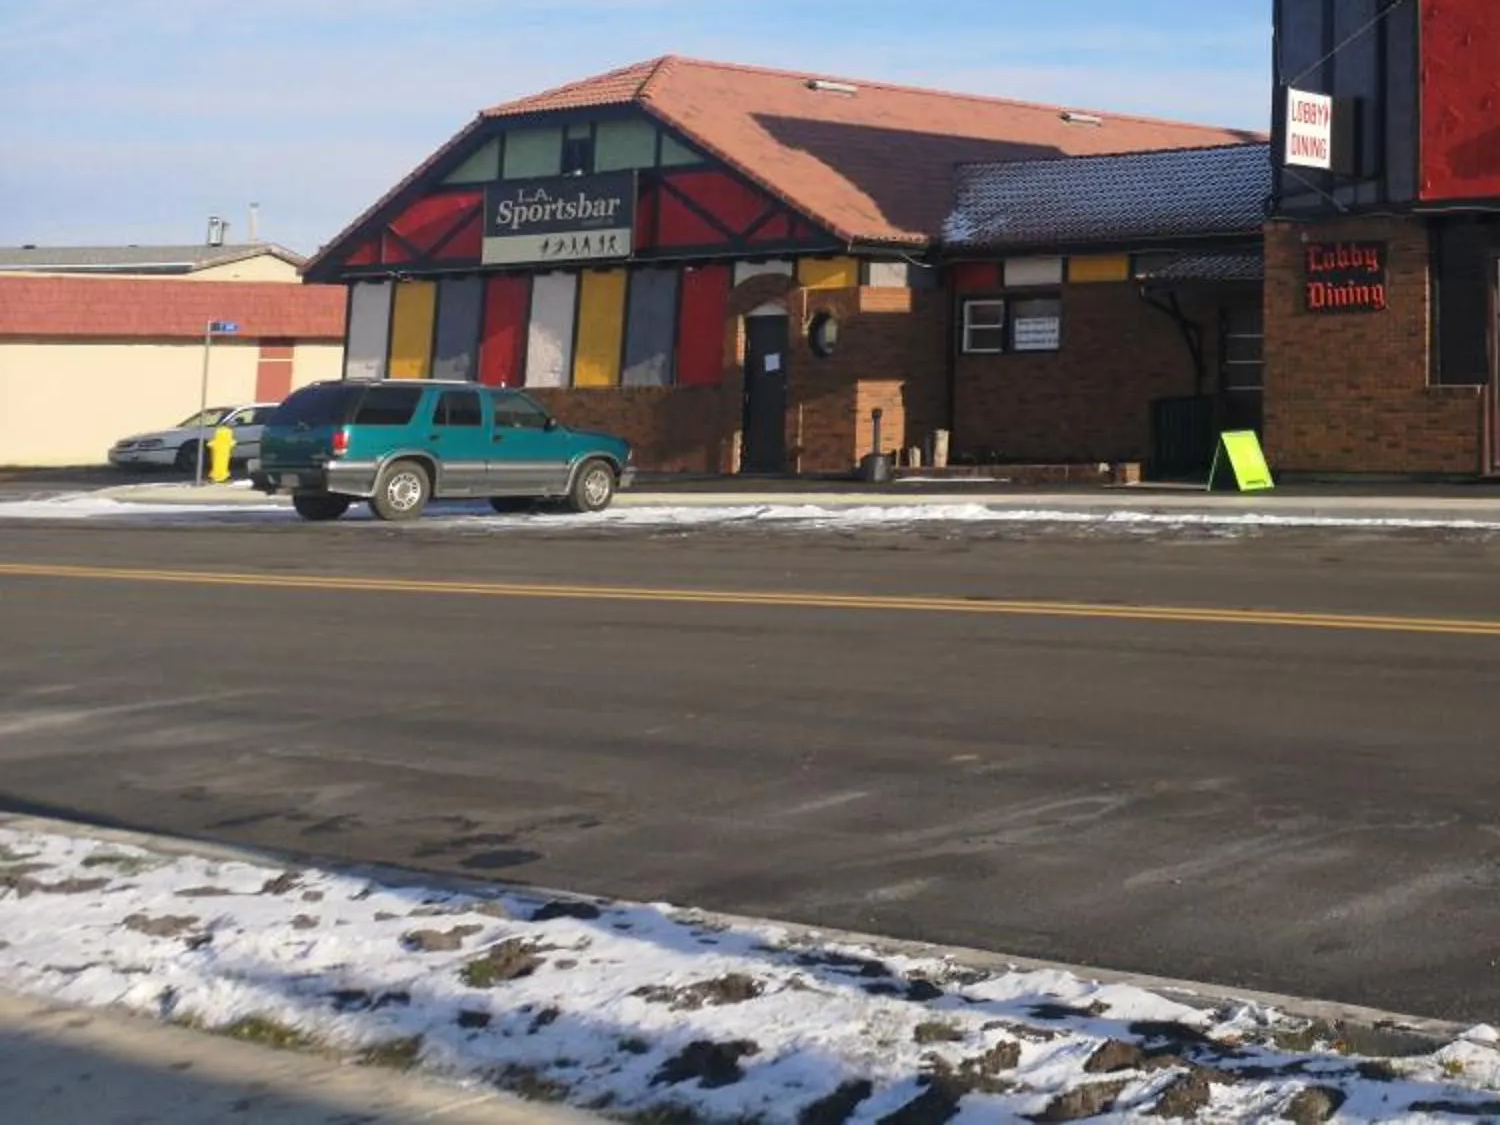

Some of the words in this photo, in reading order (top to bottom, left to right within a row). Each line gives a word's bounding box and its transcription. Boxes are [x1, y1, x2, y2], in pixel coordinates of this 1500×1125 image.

[1291, 132, 1327, 160] DINING
[495, 192, 621, 230] Sportsbar
[1307, 242, 1379, 271] Lobby
[1307, 279, 1386, 310] Dining
